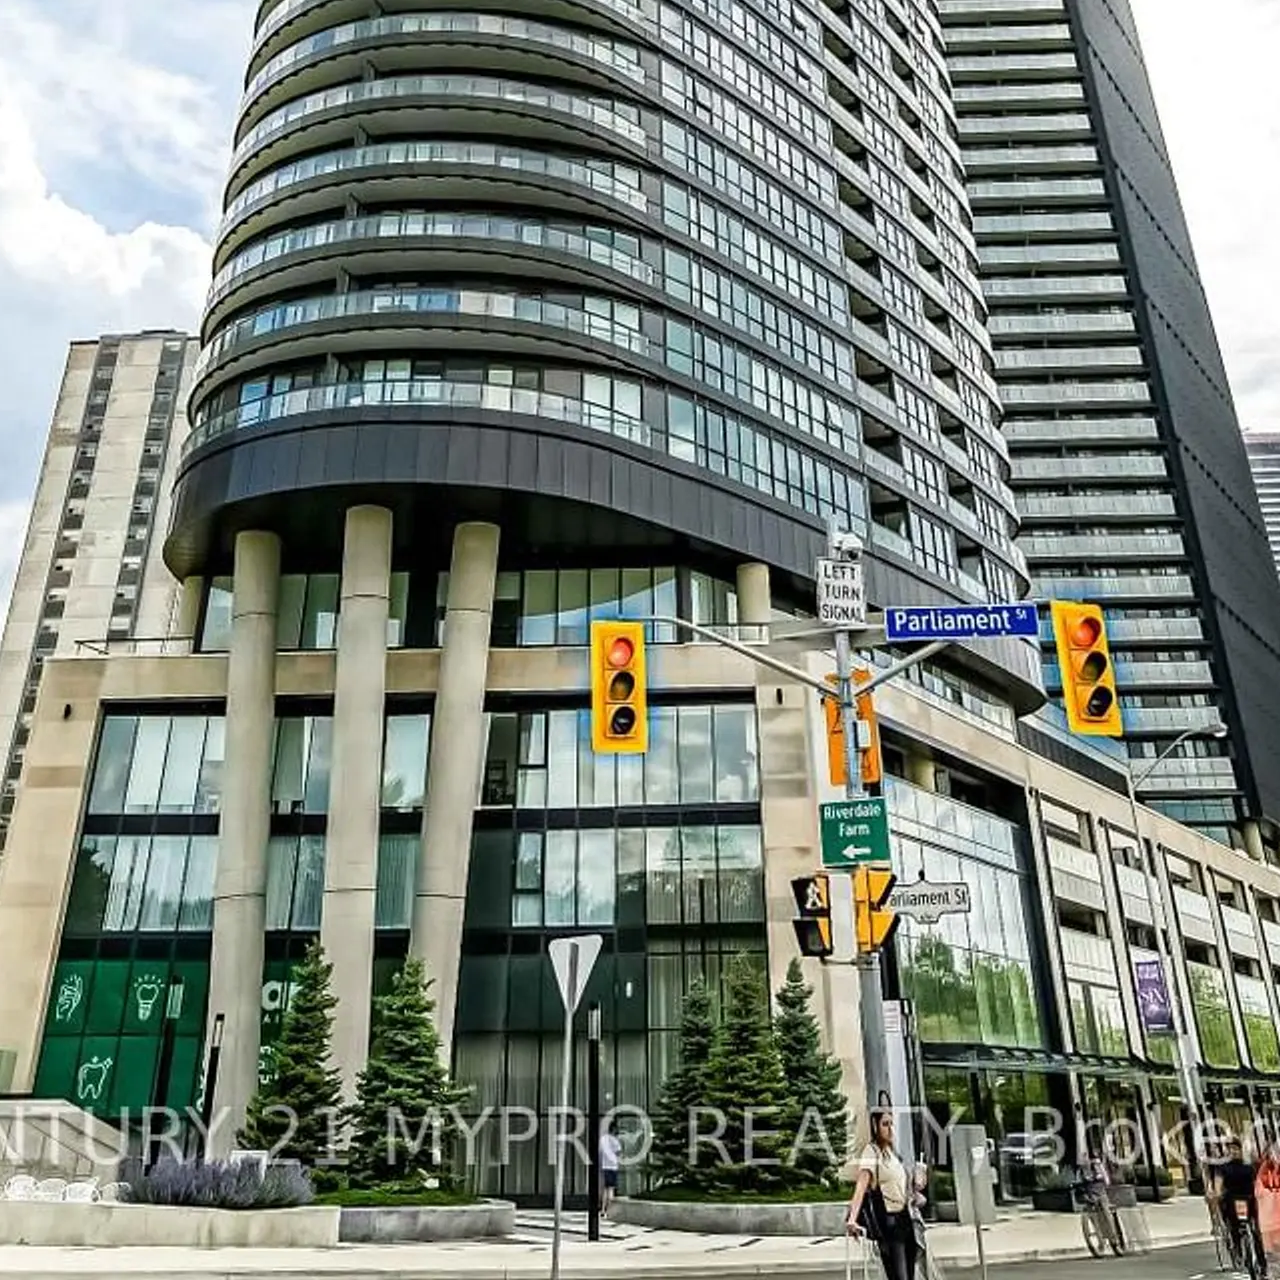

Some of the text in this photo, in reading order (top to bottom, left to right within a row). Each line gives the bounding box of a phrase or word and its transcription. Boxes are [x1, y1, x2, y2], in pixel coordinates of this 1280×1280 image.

[823, 566, 856, 581] LEFT
[824, 584, 861, 600] TURN
[822, 604, 863, 622] SIGNAL
[894, 609, 1027, 632] Parliament St
[824, 803, 881, 818] Riverdale
[839, 823, 869, 837] Farm
[890, 889, 967, 906] arliament St
